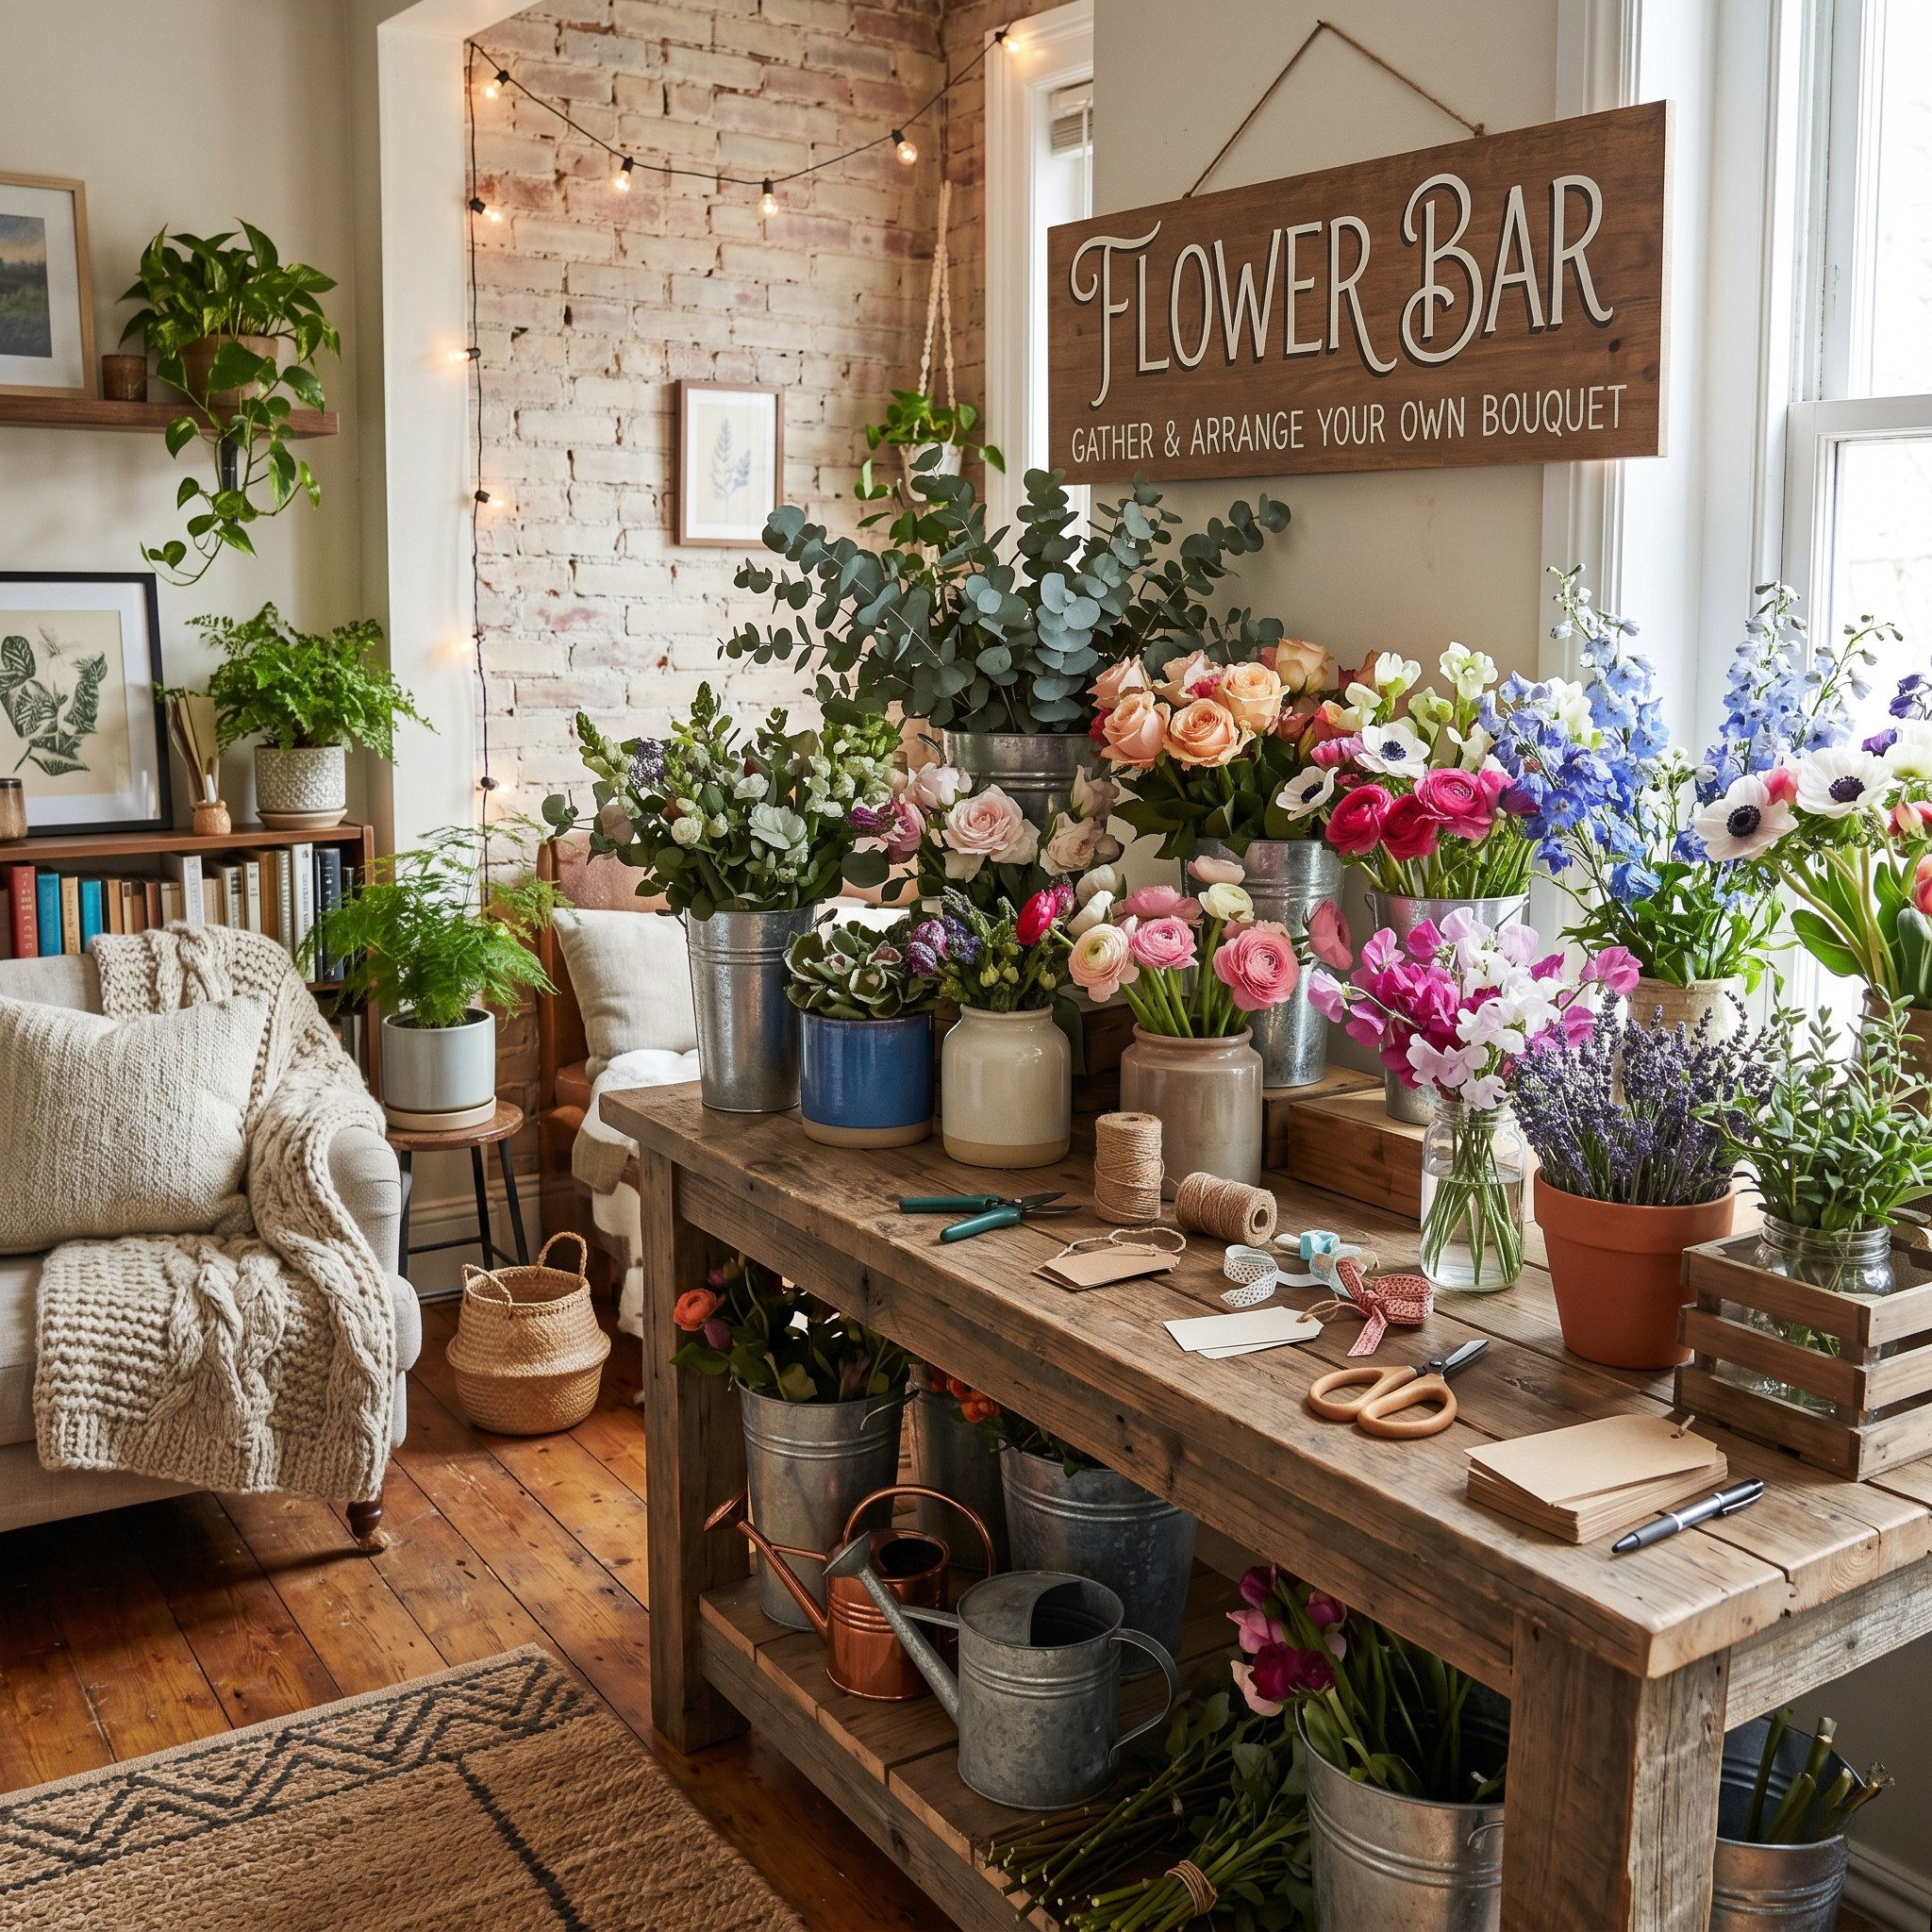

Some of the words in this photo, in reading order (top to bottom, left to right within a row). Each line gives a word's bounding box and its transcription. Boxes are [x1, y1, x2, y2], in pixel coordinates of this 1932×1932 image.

[1070, 215, 1398, 408] FLOWER
[1402, 173, 1614, 364] BAR
[1071, 421, 1154, 463] GATHER
[1164, 420, 1180, 458] &
[1190, 409, 1305, 456] ARRANGE
[1316, 404, 1386, 447] YOUR
[1400, 396, 1465, 441] OWN
[1482, 384, 1627, 438] BOUQUET
